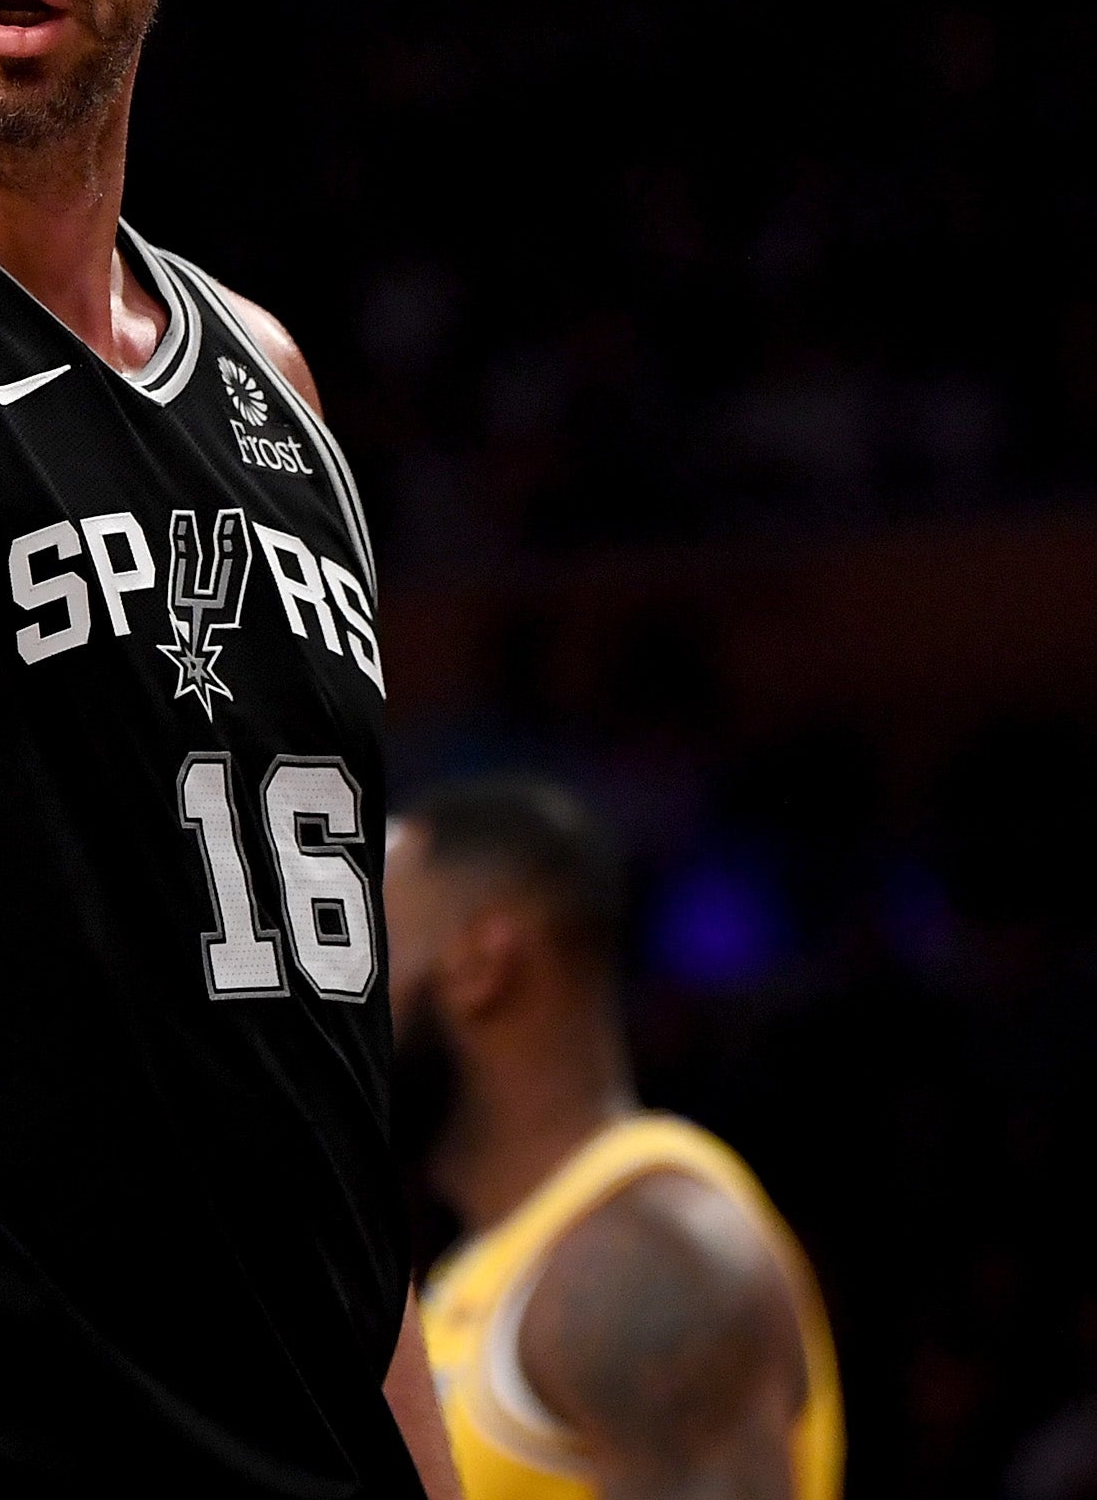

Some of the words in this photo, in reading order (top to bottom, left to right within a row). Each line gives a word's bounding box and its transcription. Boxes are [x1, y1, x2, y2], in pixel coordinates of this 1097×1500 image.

[230, 419, 313, 475] Frost
[8, 508, 387, 723] SPURS
[175, 751, 378, 1004] 16
